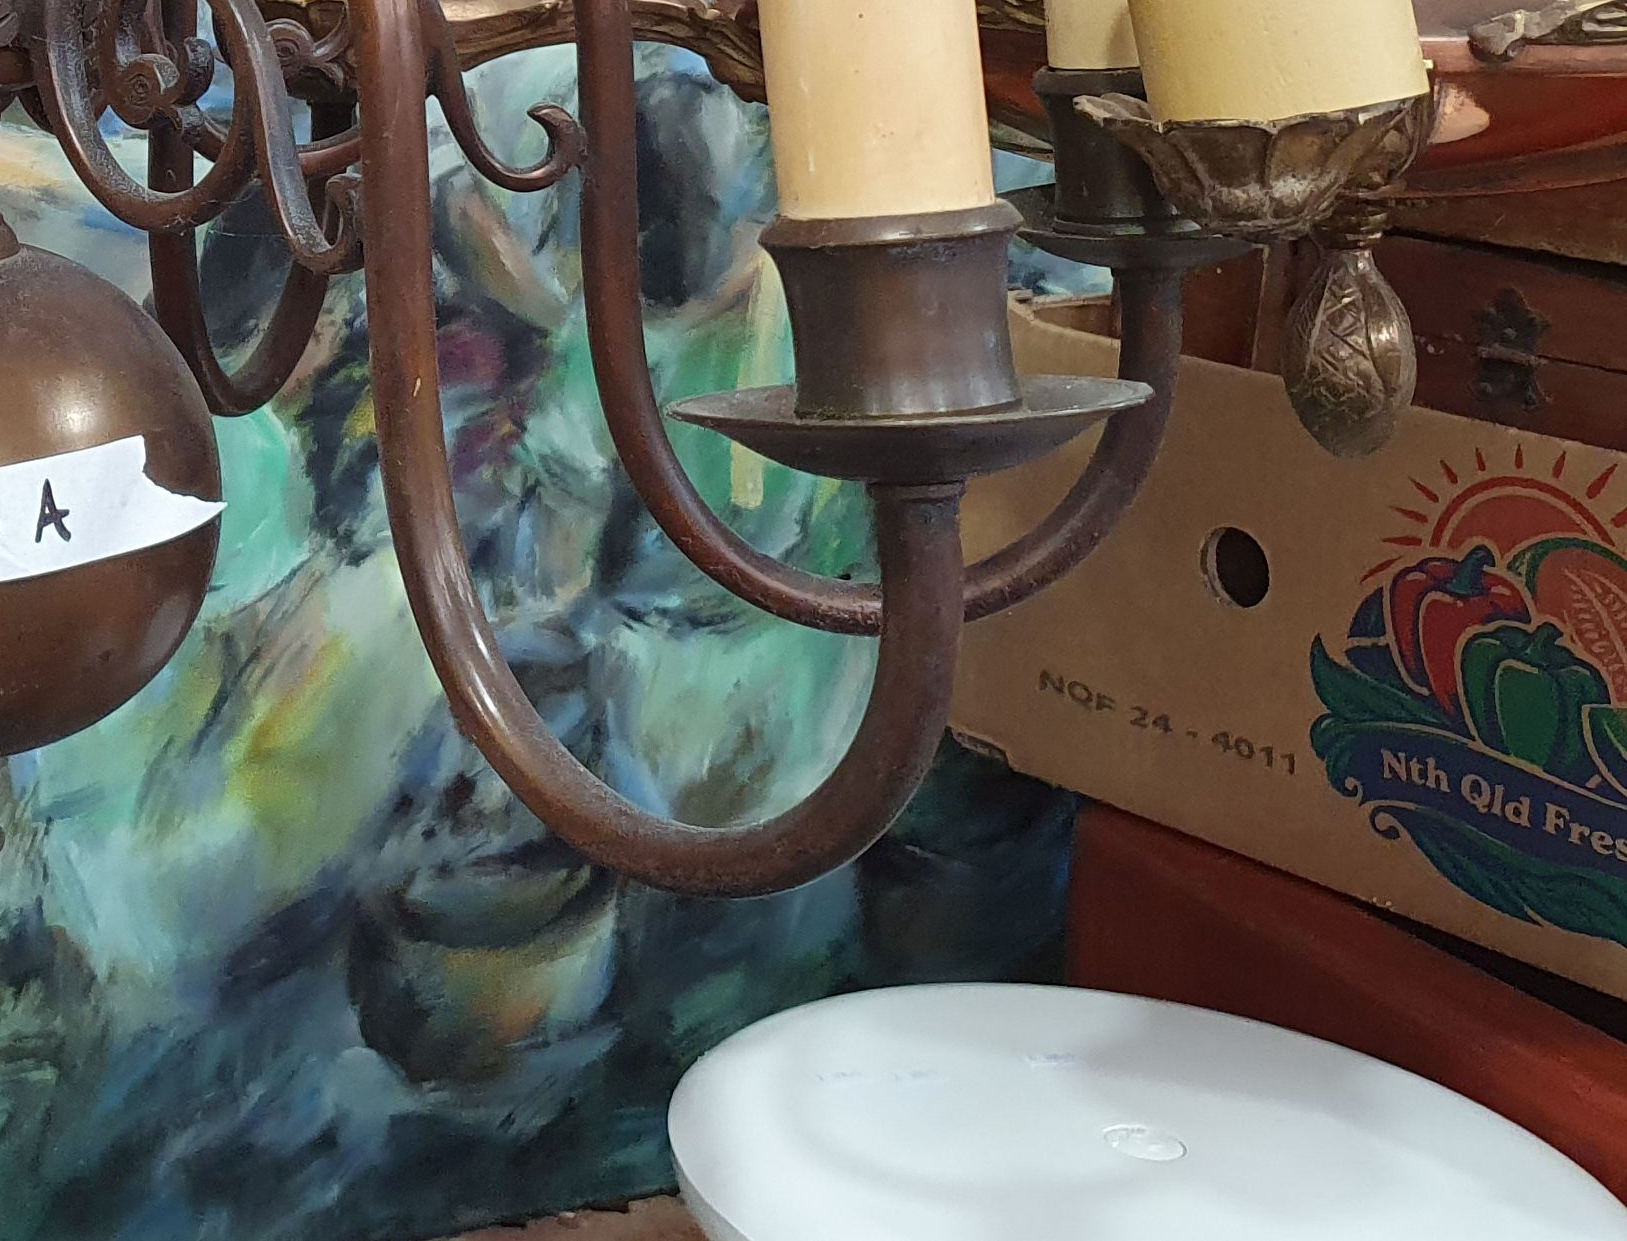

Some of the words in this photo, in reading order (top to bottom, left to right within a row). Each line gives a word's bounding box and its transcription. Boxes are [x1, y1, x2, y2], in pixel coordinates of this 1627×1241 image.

[35, 478, 71, 542] A
[1038, 668, 1116, 711] NQF
[1129, 705, 1172, 734] 24
[1211, 730, 1296, 776] 4011
[1380, 747, 1451, 793] Nth
[1460, 773, 1532, 828] Qld
